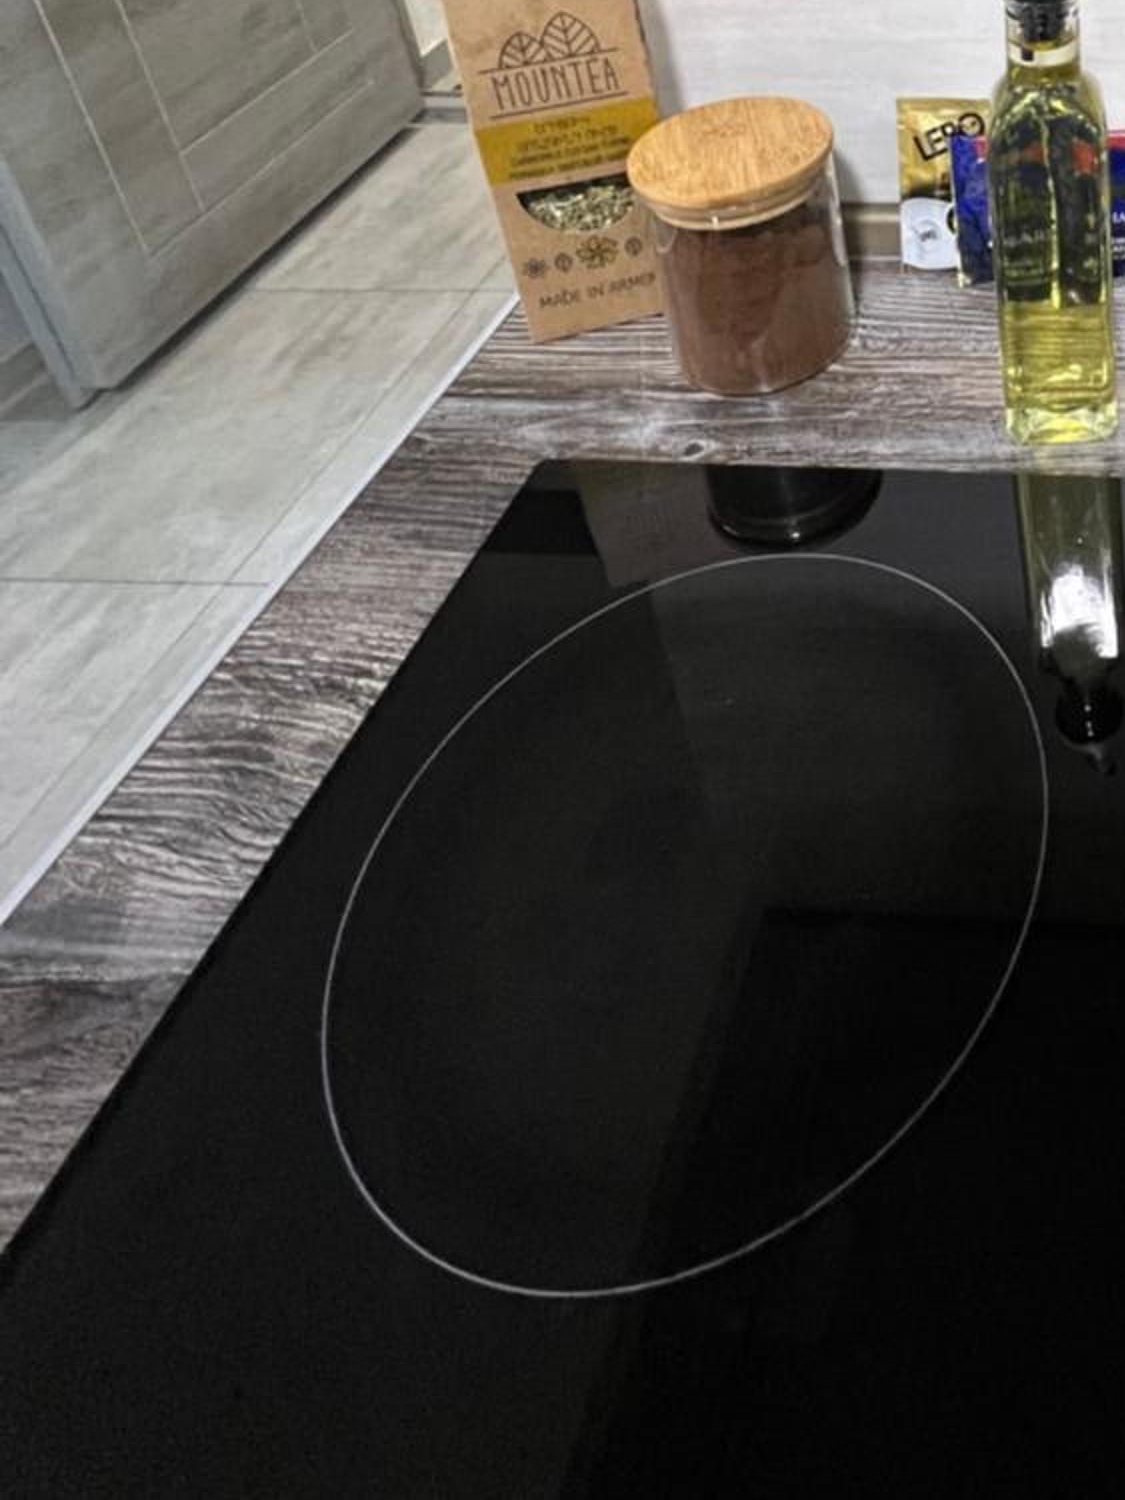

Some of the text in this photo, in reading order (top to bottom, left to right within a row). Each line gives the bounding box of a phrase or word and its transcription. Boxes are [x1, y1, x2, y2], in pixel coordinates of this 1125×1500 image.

[490, 57, 620, 110] MOUNTEA
[539, 289, 580, 308] MADE
[586, 284, 604, 298] IN
